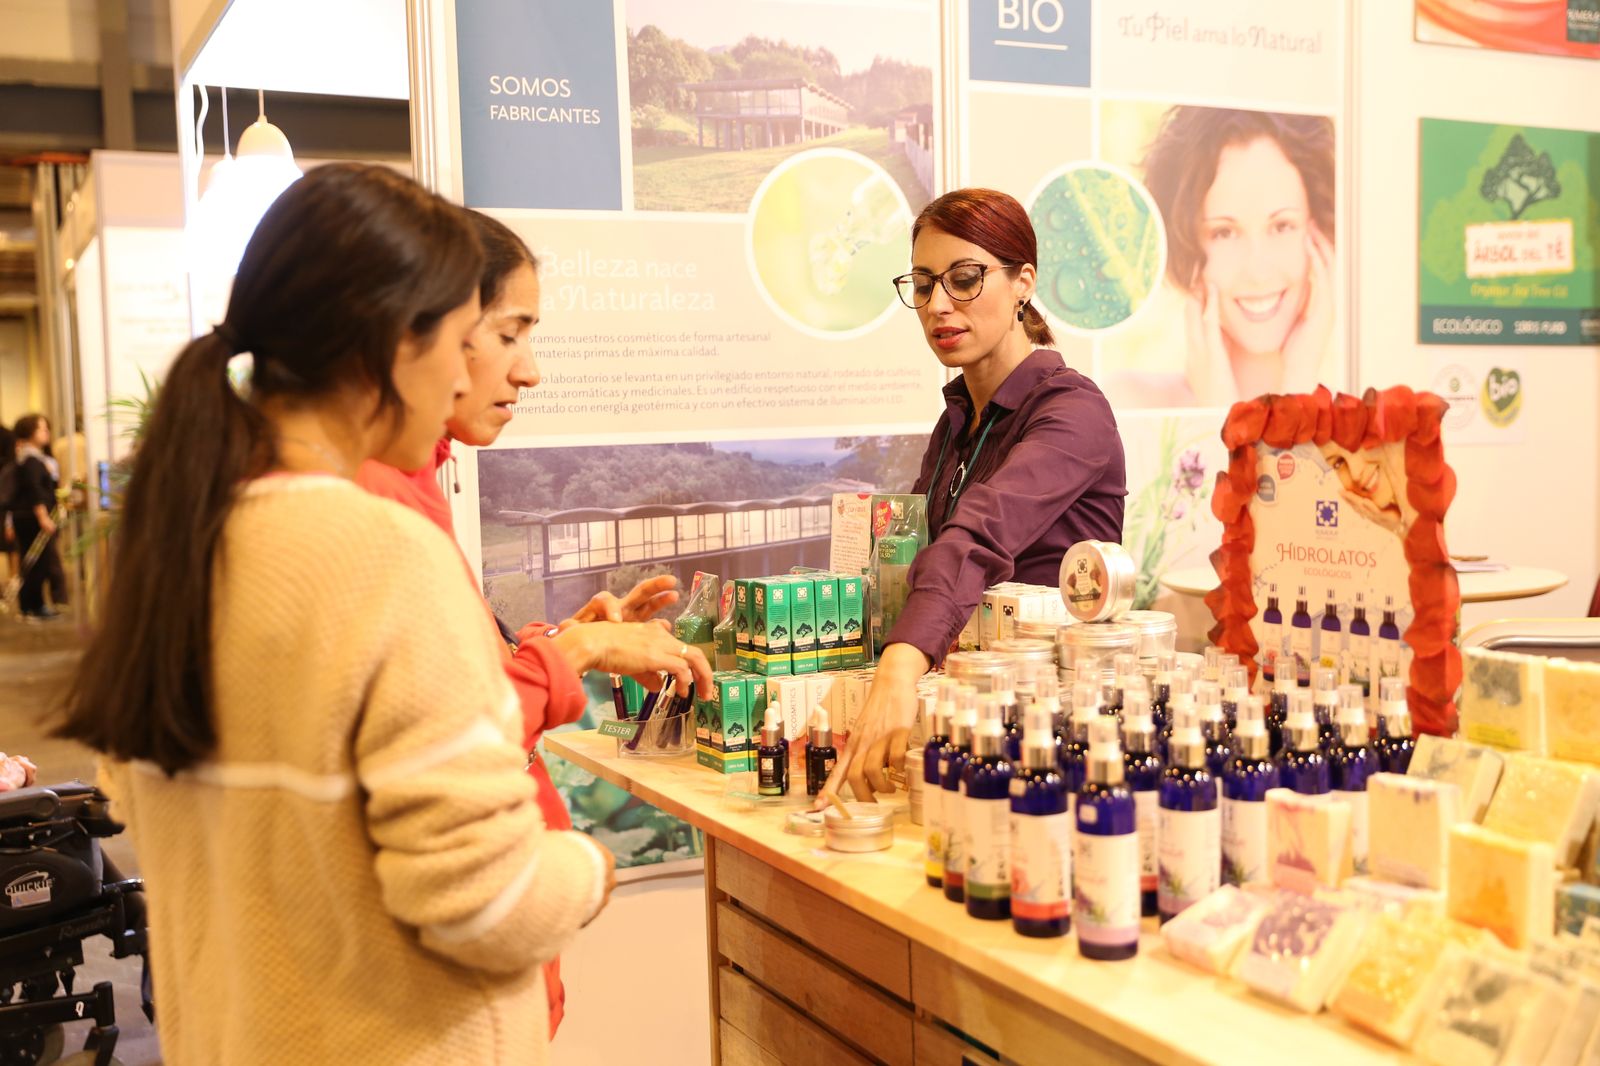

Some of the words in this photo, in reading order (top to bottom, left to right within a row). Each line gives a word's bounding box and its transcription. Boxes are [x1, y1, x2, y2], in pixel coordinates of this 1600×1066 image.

[997, 0, 1064, 33] BIO
[1117, 14, 1144, 38] Tu
[1145, 10, 1189, 42] Piel
[1192, 27, 1228, 45] ama
[1231, 25, 1247, 46] lo
[1248, 25, 1323, 54] Natural
[489, 75, 571, 98] SOMOS
[489, 104, 601, 125] FABRICANTES
[535, 245, 640, 281] Belleza
[647, 260, 697, 279] nace
[559, 284, 716, 312] Naturaleza
[1433, 316, 1503, 335] ECOLÓGICO
[569, 333, 615, 343] nuestros
[617, 332, 677, 343] cosméticos
[679, 332, 691, 343] de
[694, 332, 723, 342] forma
[726, 332, 771, 342] artesanal
[535, 348, 581, 359] materias
[584, 348, 620, 360] primas
[622, 348, 635, 358] de
[638, 347, 678, 357] máxima
[681, 346, 719, 357] calidad.
[550, 372, 608, 384] laboratorio
[610, 375, 622, 383] se
[625, 371, 663, 383] levanta
[665, 374, 678, 382] en
[680, 373, 693, 381] un
[696, 371, 752, 384] privilegiado
[754, 370, 793, 380] entorno
[873, 367, 885, 377] de
[520, 389, 558, 401] plantas
[561, 387, 620, 398] aromáticas
[622, 389, 629, 399] y
[631, 386, 694, 397] medicinales.
[697, 385, 708, 396] Es
[710, 386, 722, 395] un
[725, 383, 762, 395] edificio
[764, 383, 817, 395] respetuoso
[819, 383, 836, 393] con
[838, 382, 846, 391] el
[1488, 374, 1518, 401] bio
[511, 403, 565, 415] limentado
[568, 404, 588, 413] con
[590, 402, 629, 415] energía
[631, 401, 690, 414] geotérmica
[692, 401, 698, 411] y
[700, 400, 718, 410] con
[721, 400, 735, 409] un
[737, 396, 776, 409] efectivo
[778, 395, 815, 407] sistema
[817, 395, 828, 406] de
[1276, 542, 1377, 567] HIDROLATOS
[1304, 567, 1352, 579] ECOLÓGICOS
[604, 724, 632, 735] TESTER
